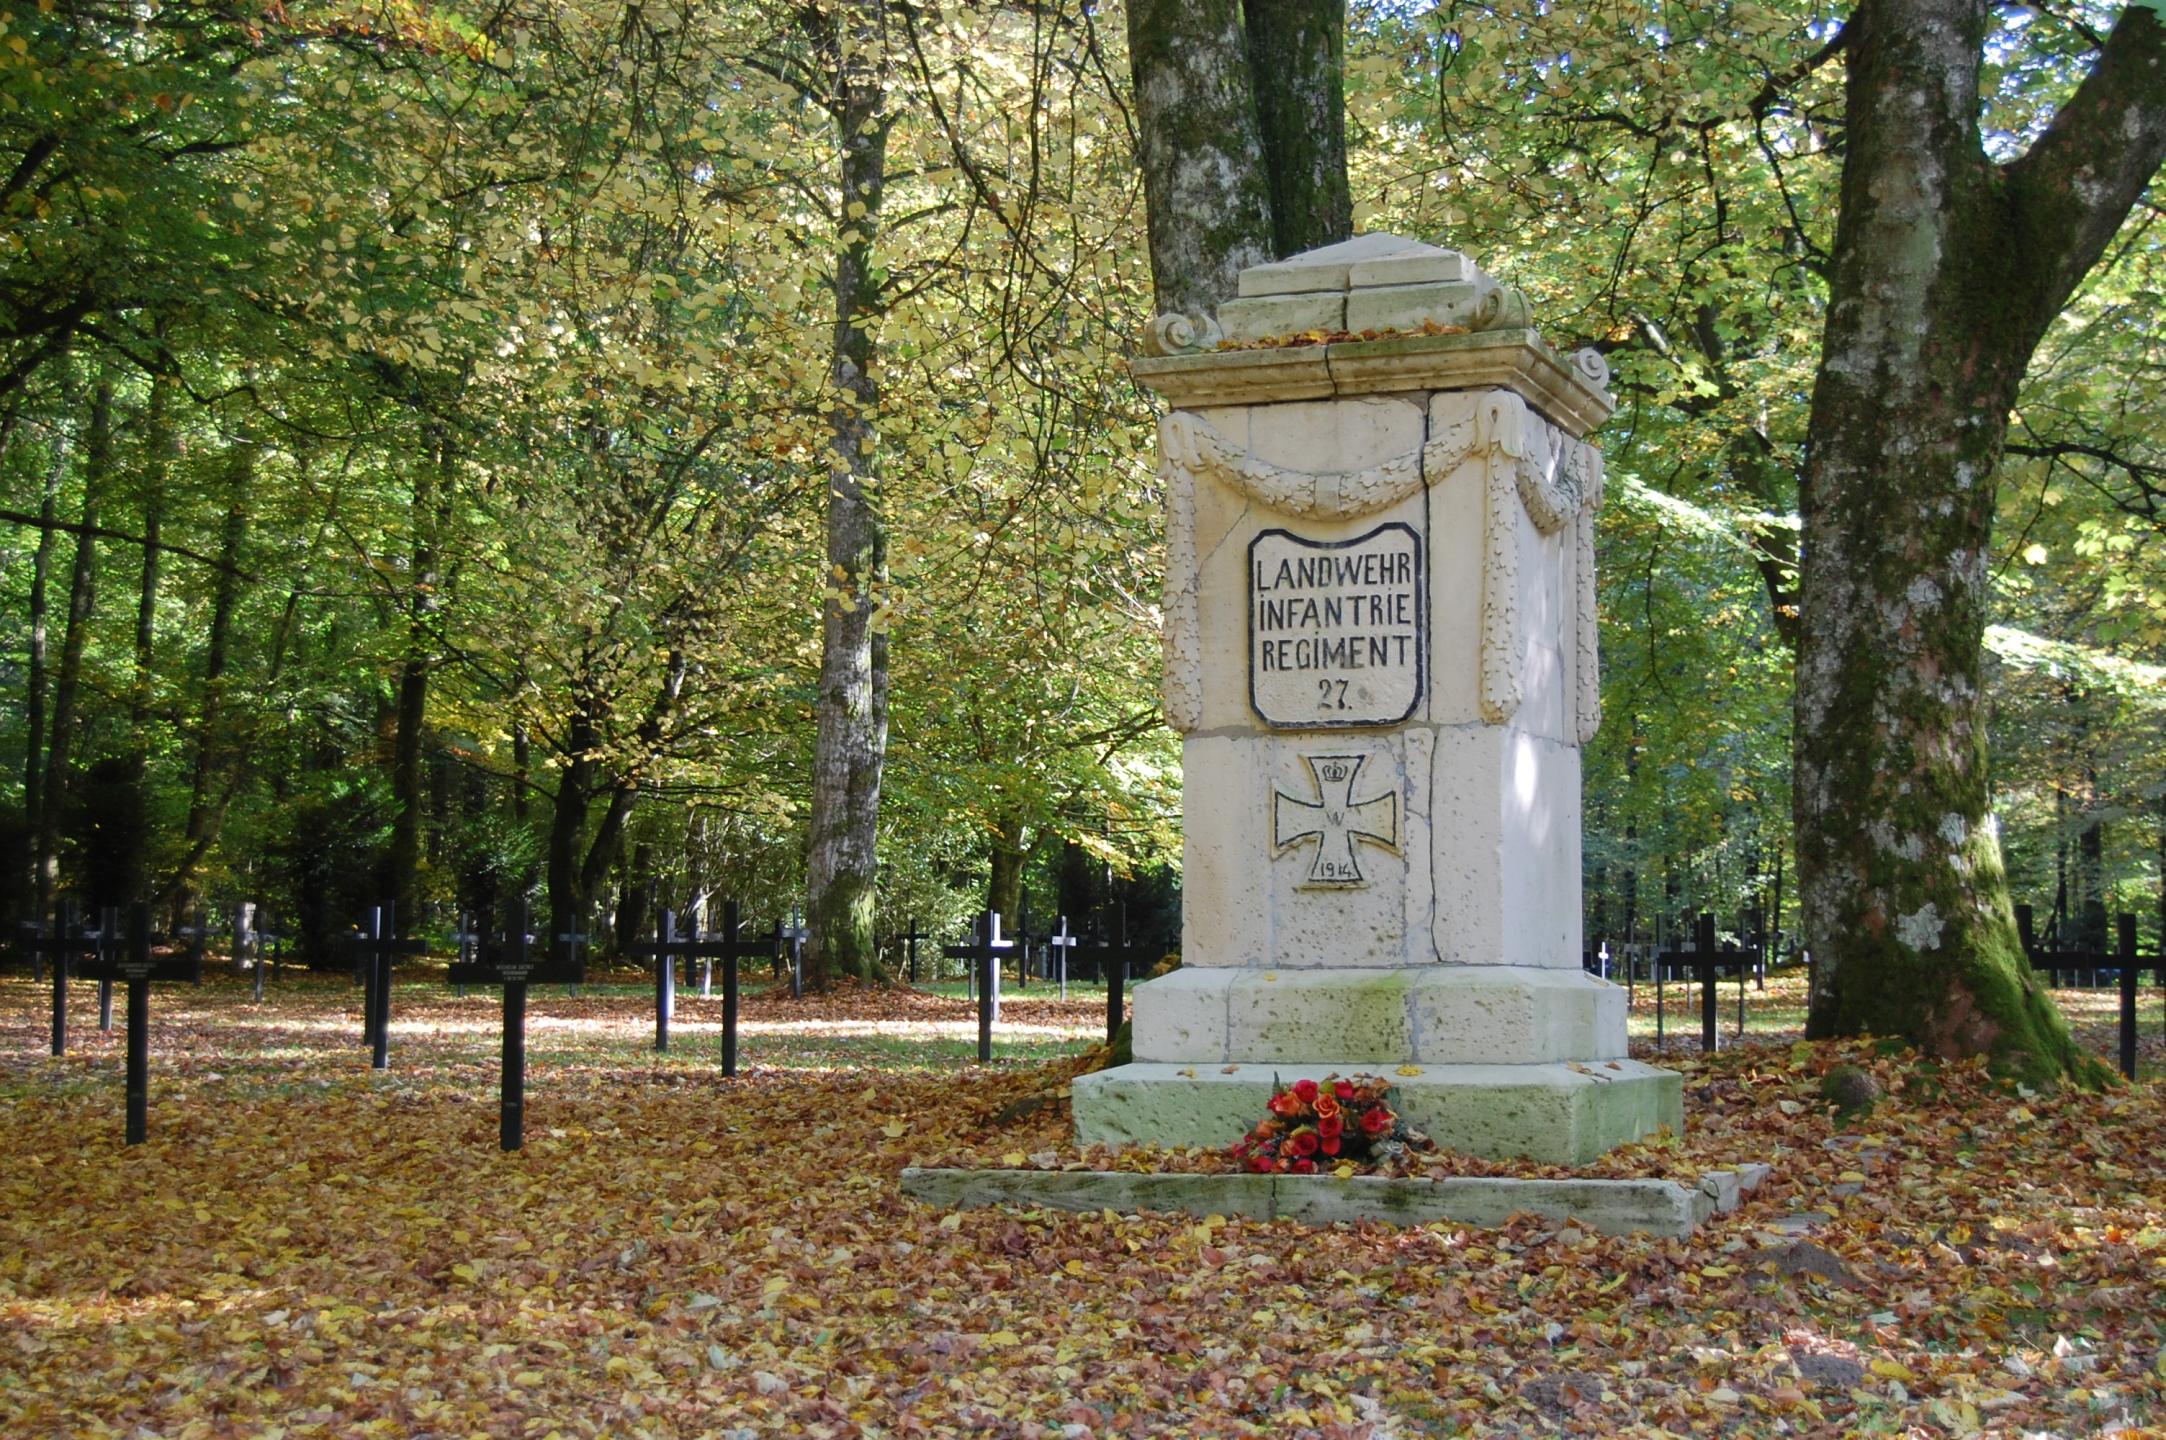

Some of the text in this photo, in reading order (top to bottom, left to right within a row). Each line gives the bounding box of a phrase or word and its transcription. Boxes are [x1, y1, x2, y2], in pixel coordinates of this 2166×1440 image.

[1257, 553, 1411, 592] LANDWEHR
[1317, 679, 1353, 710] 27.
[1326, 811, 1345, 826] W
